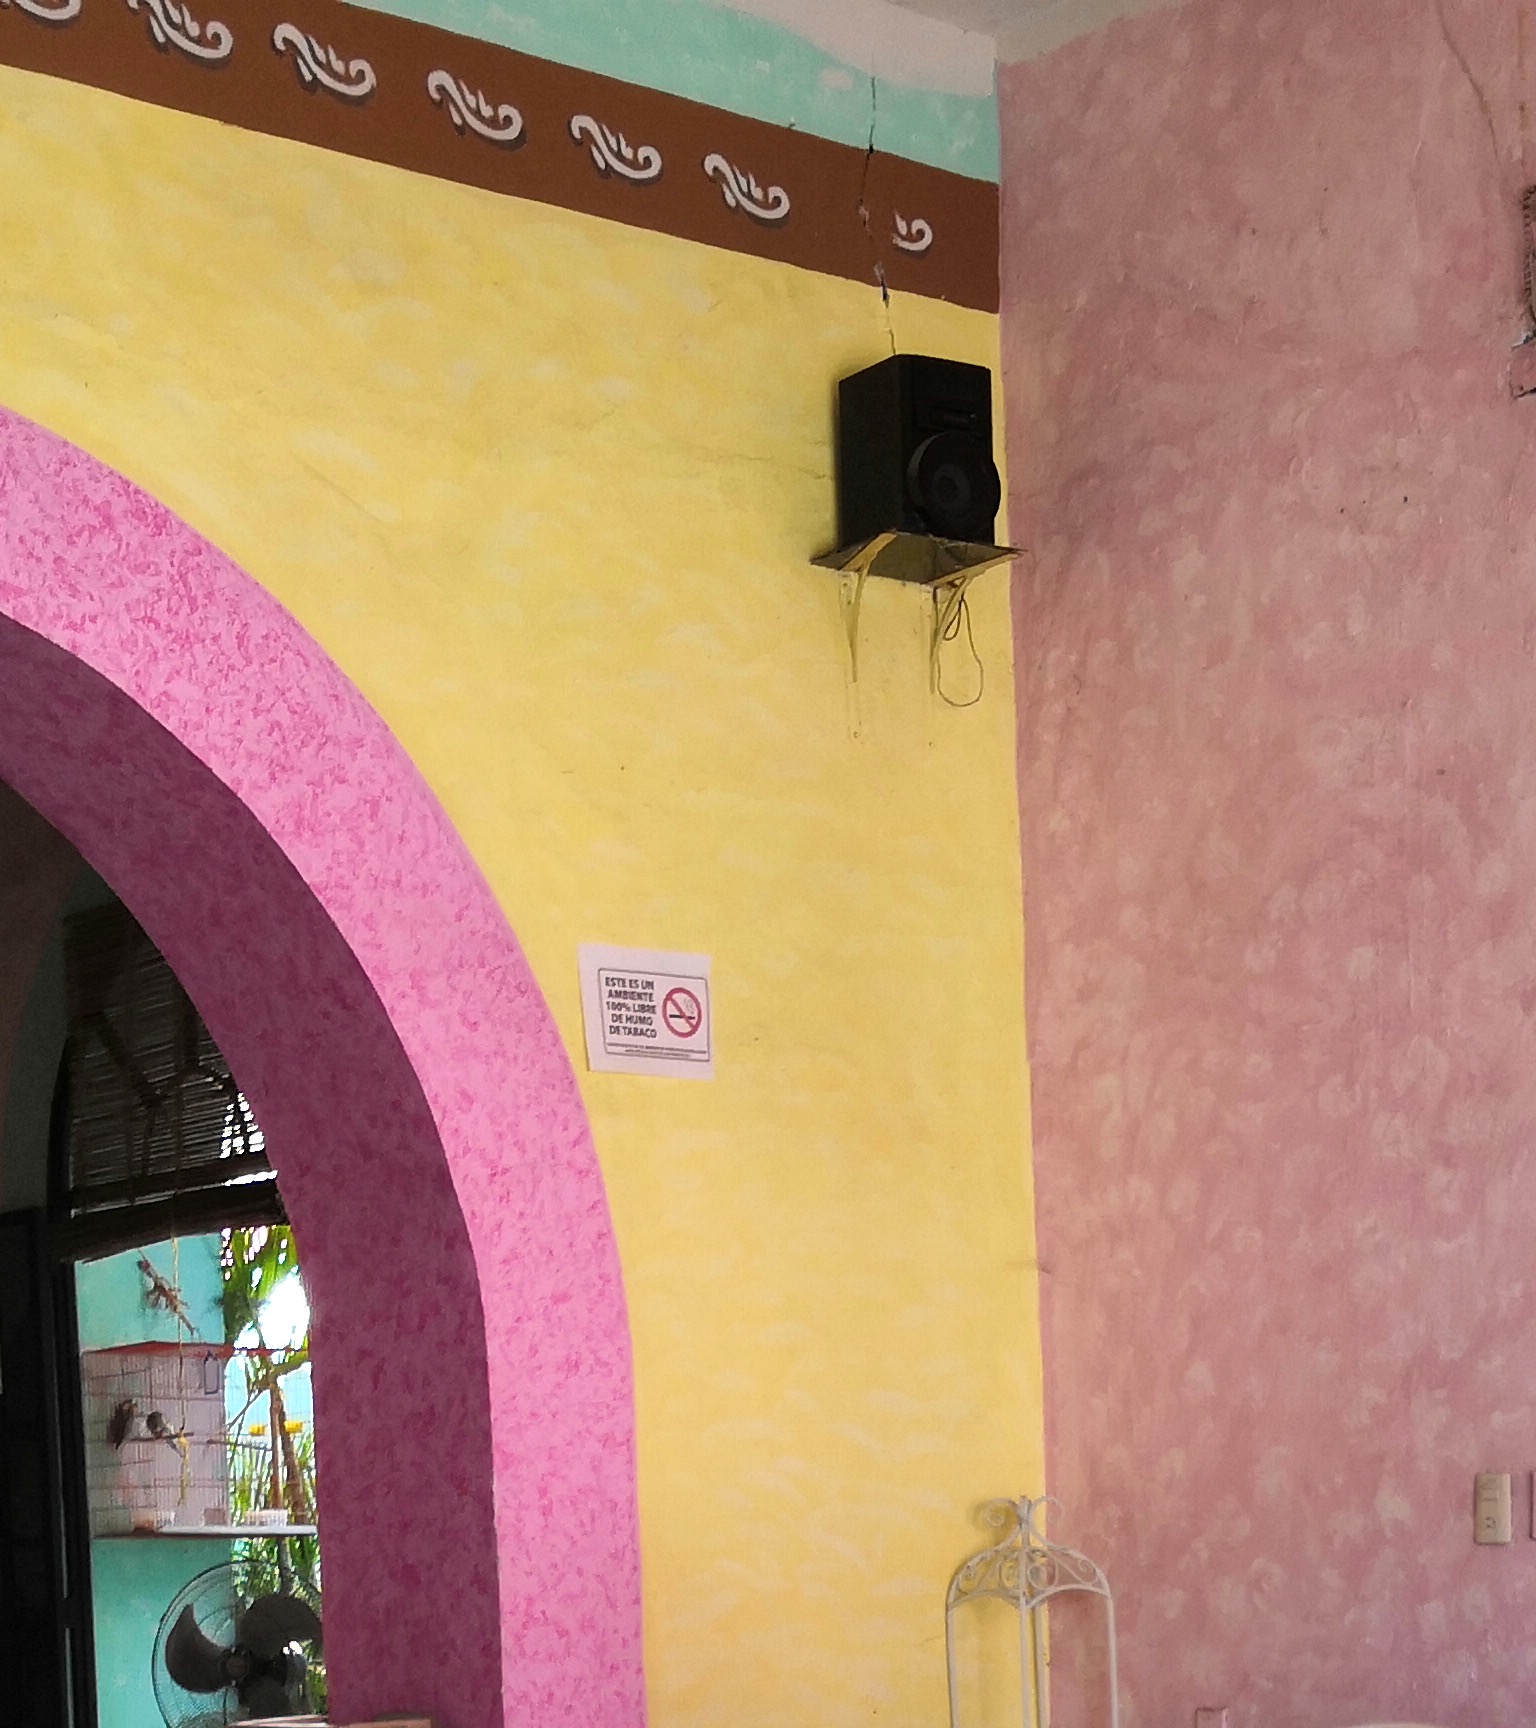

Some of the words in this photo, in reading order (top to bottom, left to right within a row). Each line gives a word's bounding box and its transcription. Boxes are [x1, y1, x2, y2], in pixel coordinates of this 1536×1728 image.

[605, 976, 627, 988] ESTE
[629, 979, 639, 989] ES
[641, 980, 654, 990] UN
[608, 989, 654, 1002] AMBIENTE
[606, 1001, 630, 1012] 100%
[633, 1004, 657, 1014] LIBRE
[611, 1013, 624, 1024] DE
[625, 1014, 653, 1026] HUMO
[609, 1025, 620, 1036] DE
[622, 1026, 657, 1038] TABACO
